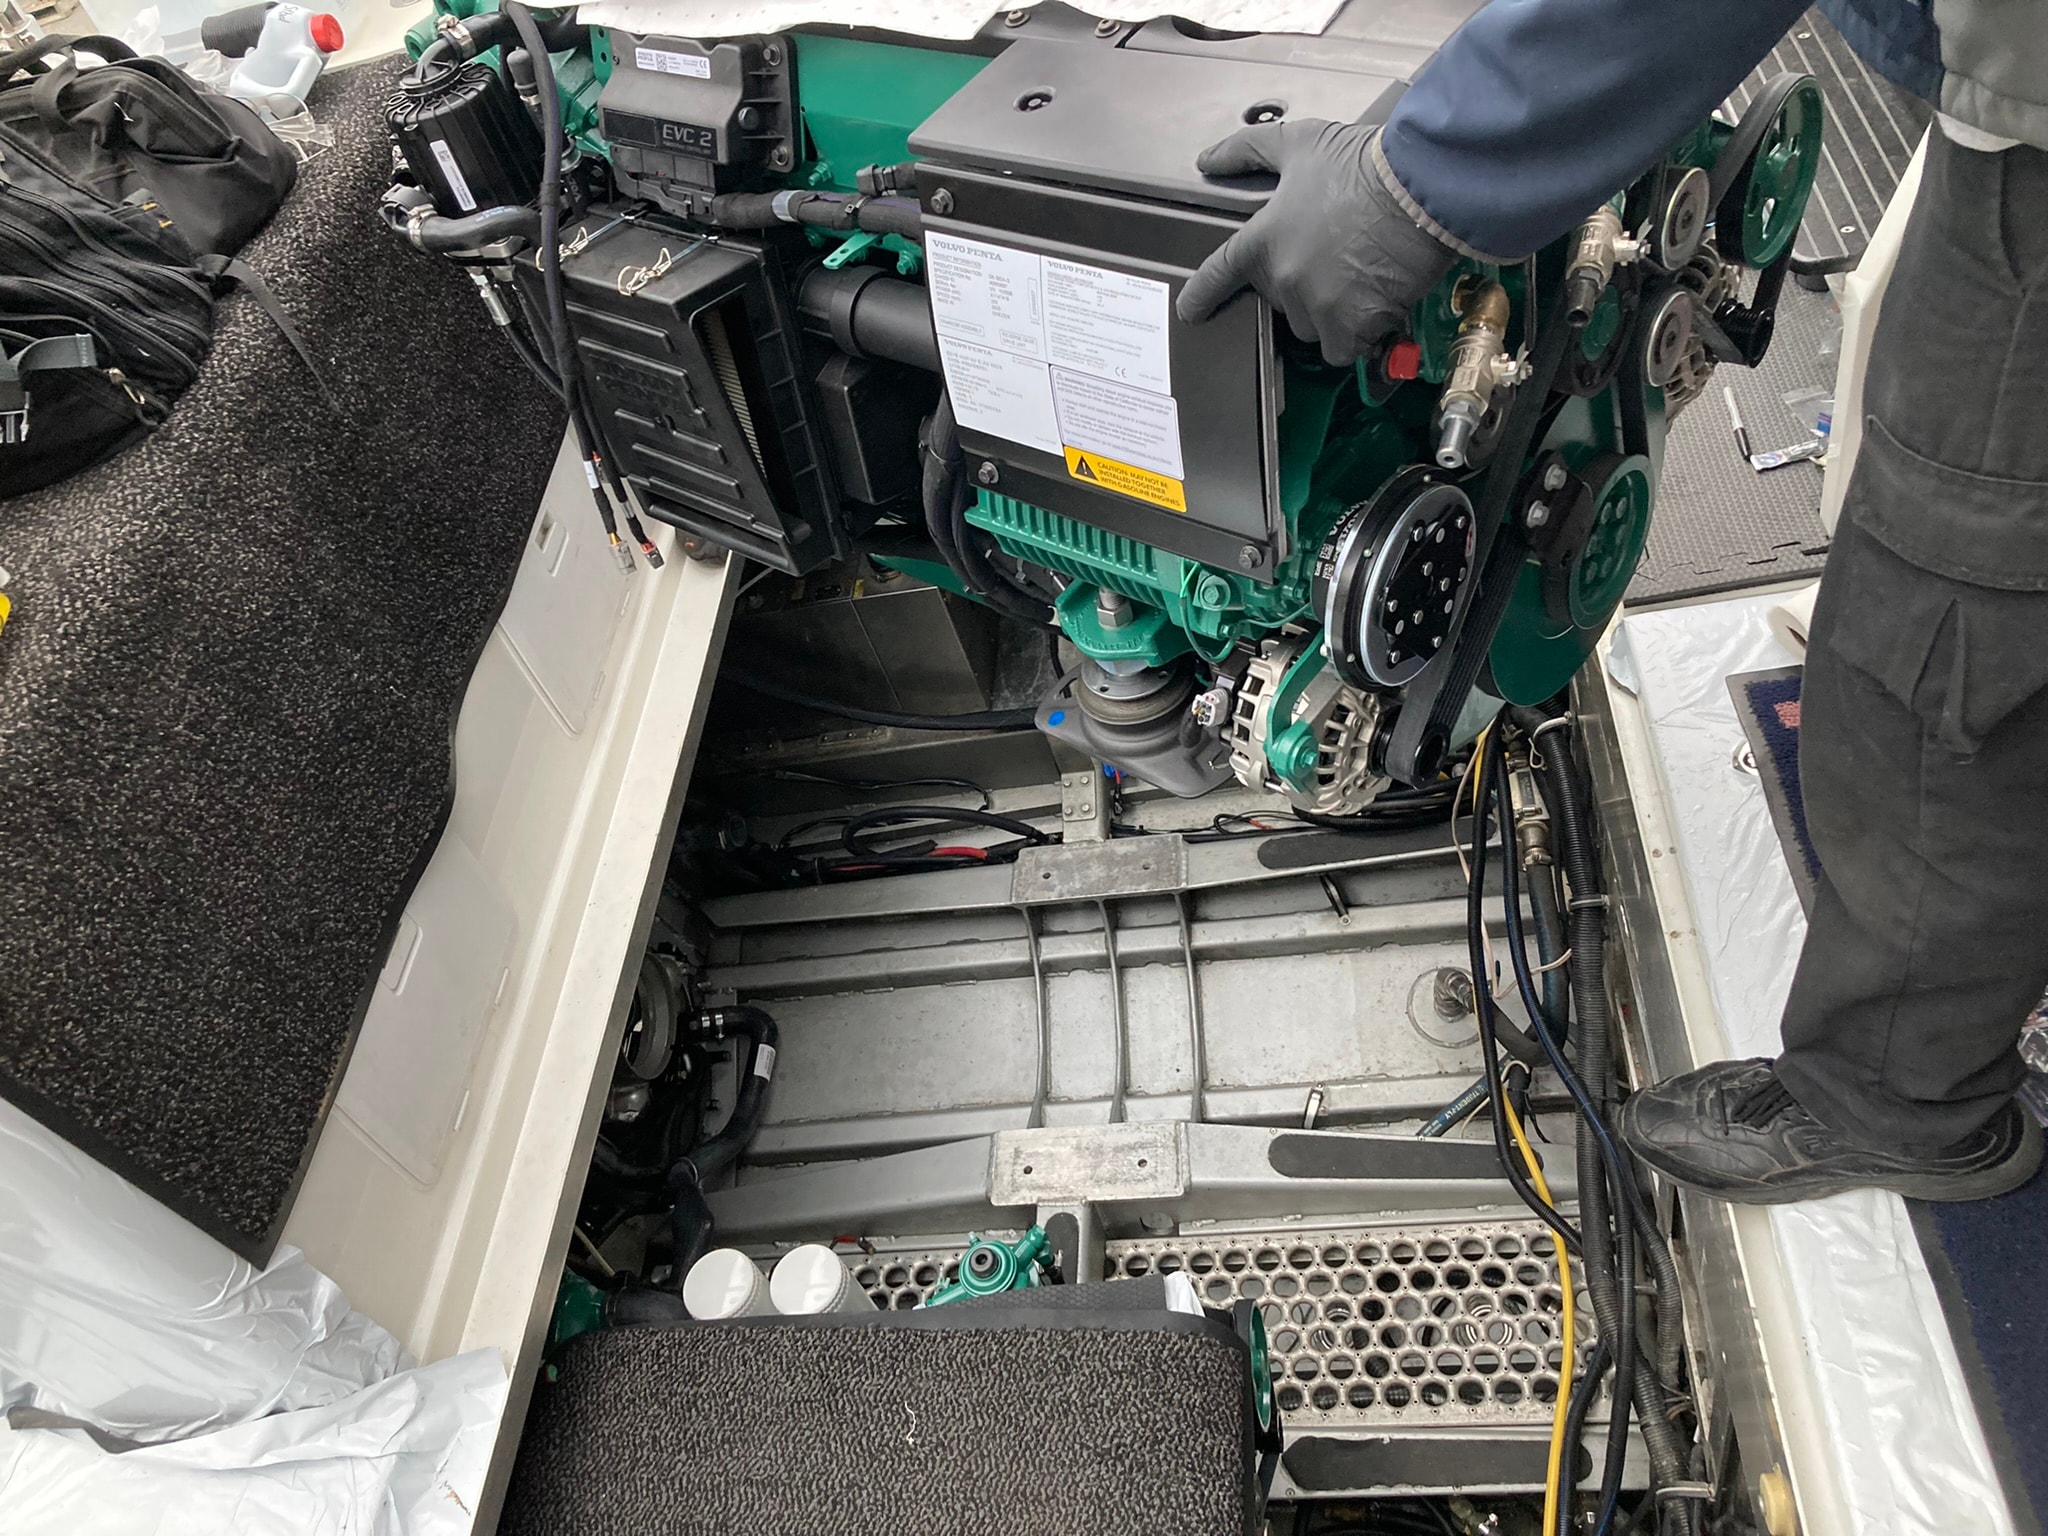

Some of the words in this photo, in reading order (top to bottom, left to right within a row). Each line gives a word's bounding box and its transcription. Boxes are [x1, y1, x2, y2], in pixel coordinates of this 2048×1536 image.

[662, 123, 695, 144] EVC
[700, 131, 712, 147] 2
[933, 239, 966, 254] VOLVO
[967, 247, 1003, 262] PENTA
[1047, 260, 1074, 272] VOLVO
[1075, 267, 1103, 279] PENTA
[1098, 469, 1132, 485] INSTALLED
[1131, 479, 1166, 494] TOGETHER
[1101, 476, 1118, 488] WITH
[1117, 481, 1150, 497] GASOLINE
[1150, 491, 1181, 507] ENGINES
[1145, 474, 1160, 486] NOT
